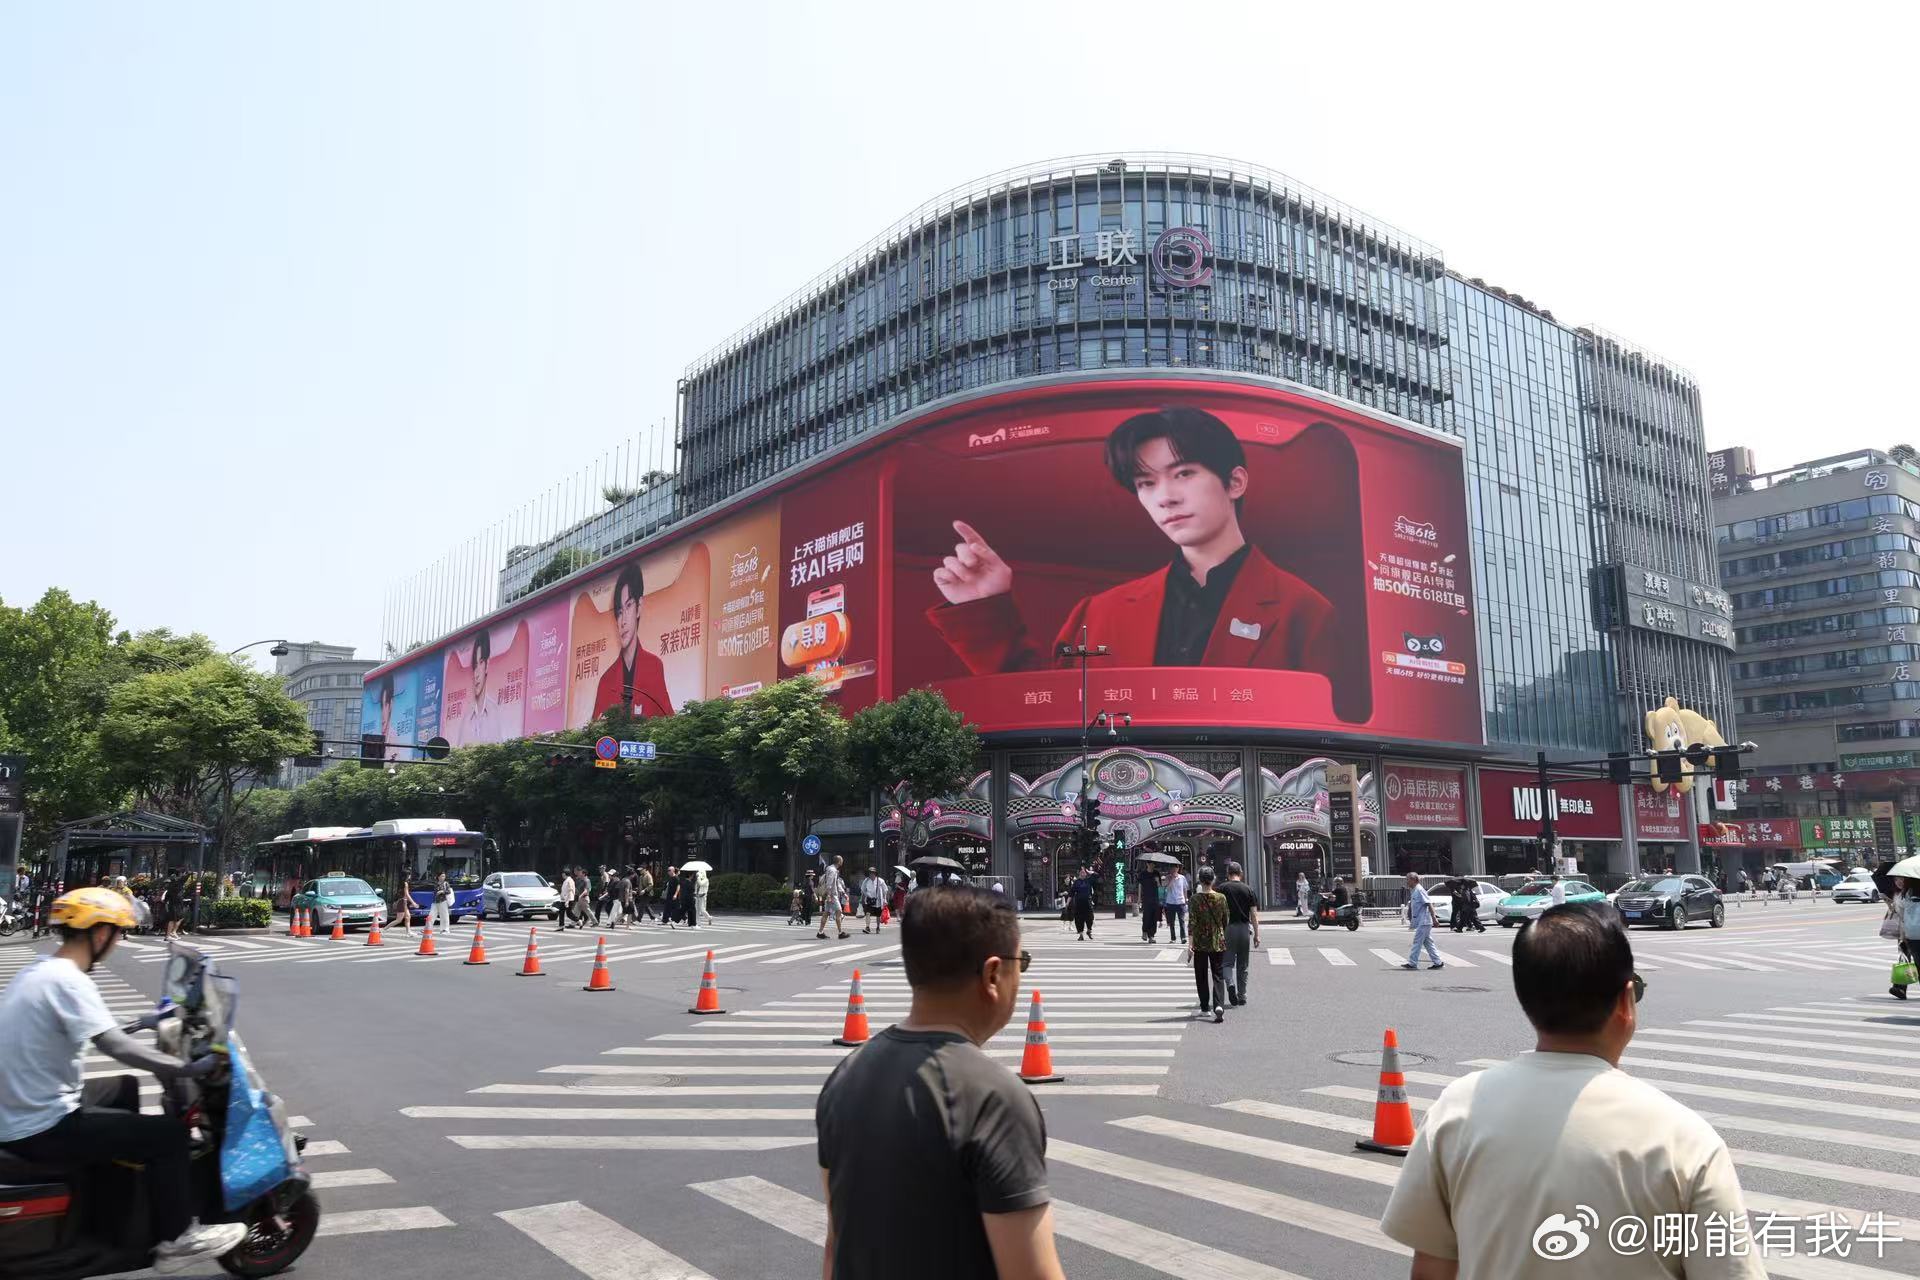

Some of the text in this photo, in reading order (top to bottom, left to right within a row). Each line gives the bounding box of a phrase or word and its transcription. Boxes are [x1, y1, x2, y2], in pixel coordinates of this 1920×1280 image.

[1047, 229, 1138, 271] 工联
[1047, 274, 1138, 290] City Center
[790, 522, 864, 563] 上天猫旗舰店
[1394, 521, 1437, 541] 天猫618
[790, 541, 865, 588] 找AI导购
[660, 622, 701, 656] 家装效果
[801, 621, 827, 649] 导购
[1024, 688, 1254, 705] 首页 宝贝 新品 会员
[1402, 779, 1461, 799] 海底捞火锅
[1560, 797, 1593, 815] 無印良品
